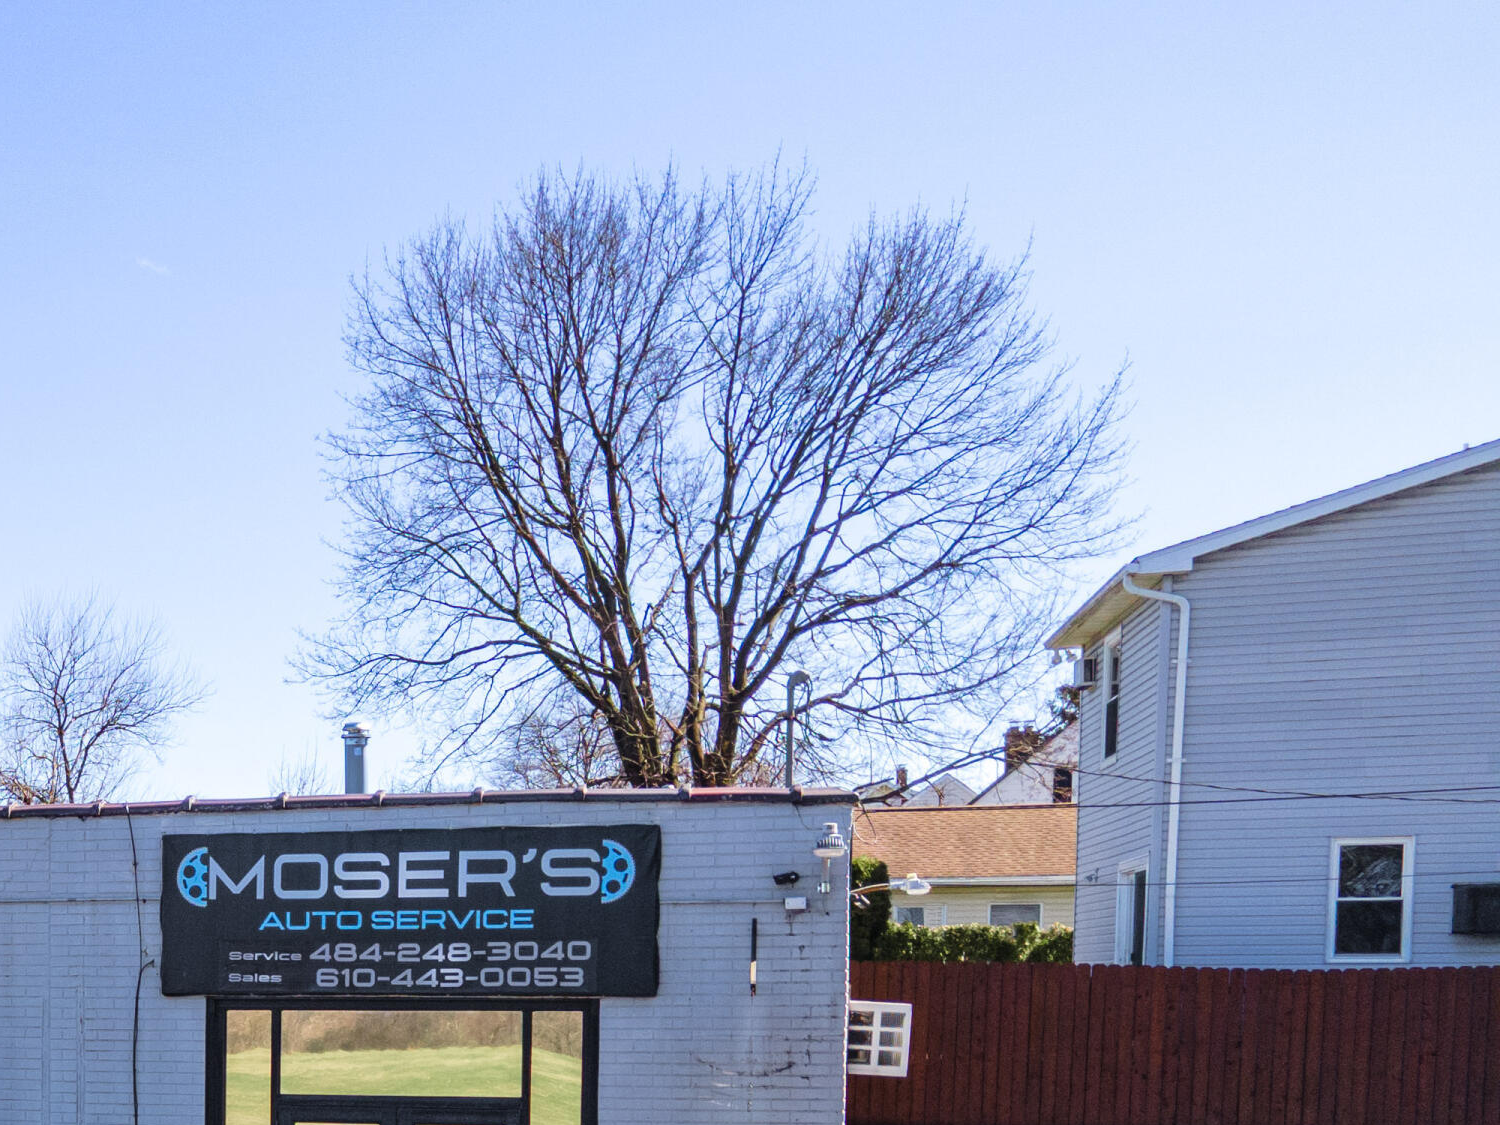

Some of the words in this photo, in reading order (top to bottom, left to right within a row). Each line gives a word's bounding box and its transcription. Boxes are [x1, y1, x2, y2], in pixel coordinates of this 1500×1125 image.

[208, 848, 601, 901] MOSER'S
[258, 911, 363, 931] AUTO
[371, 908, 535, 931] SERVICE
[228, 950, 303, 962] Service
[309, 940, 592, 963] 484-248-3040
[228, 973, 283, 984] Sales
[316, 966, 585, 988] 610-443-0053
